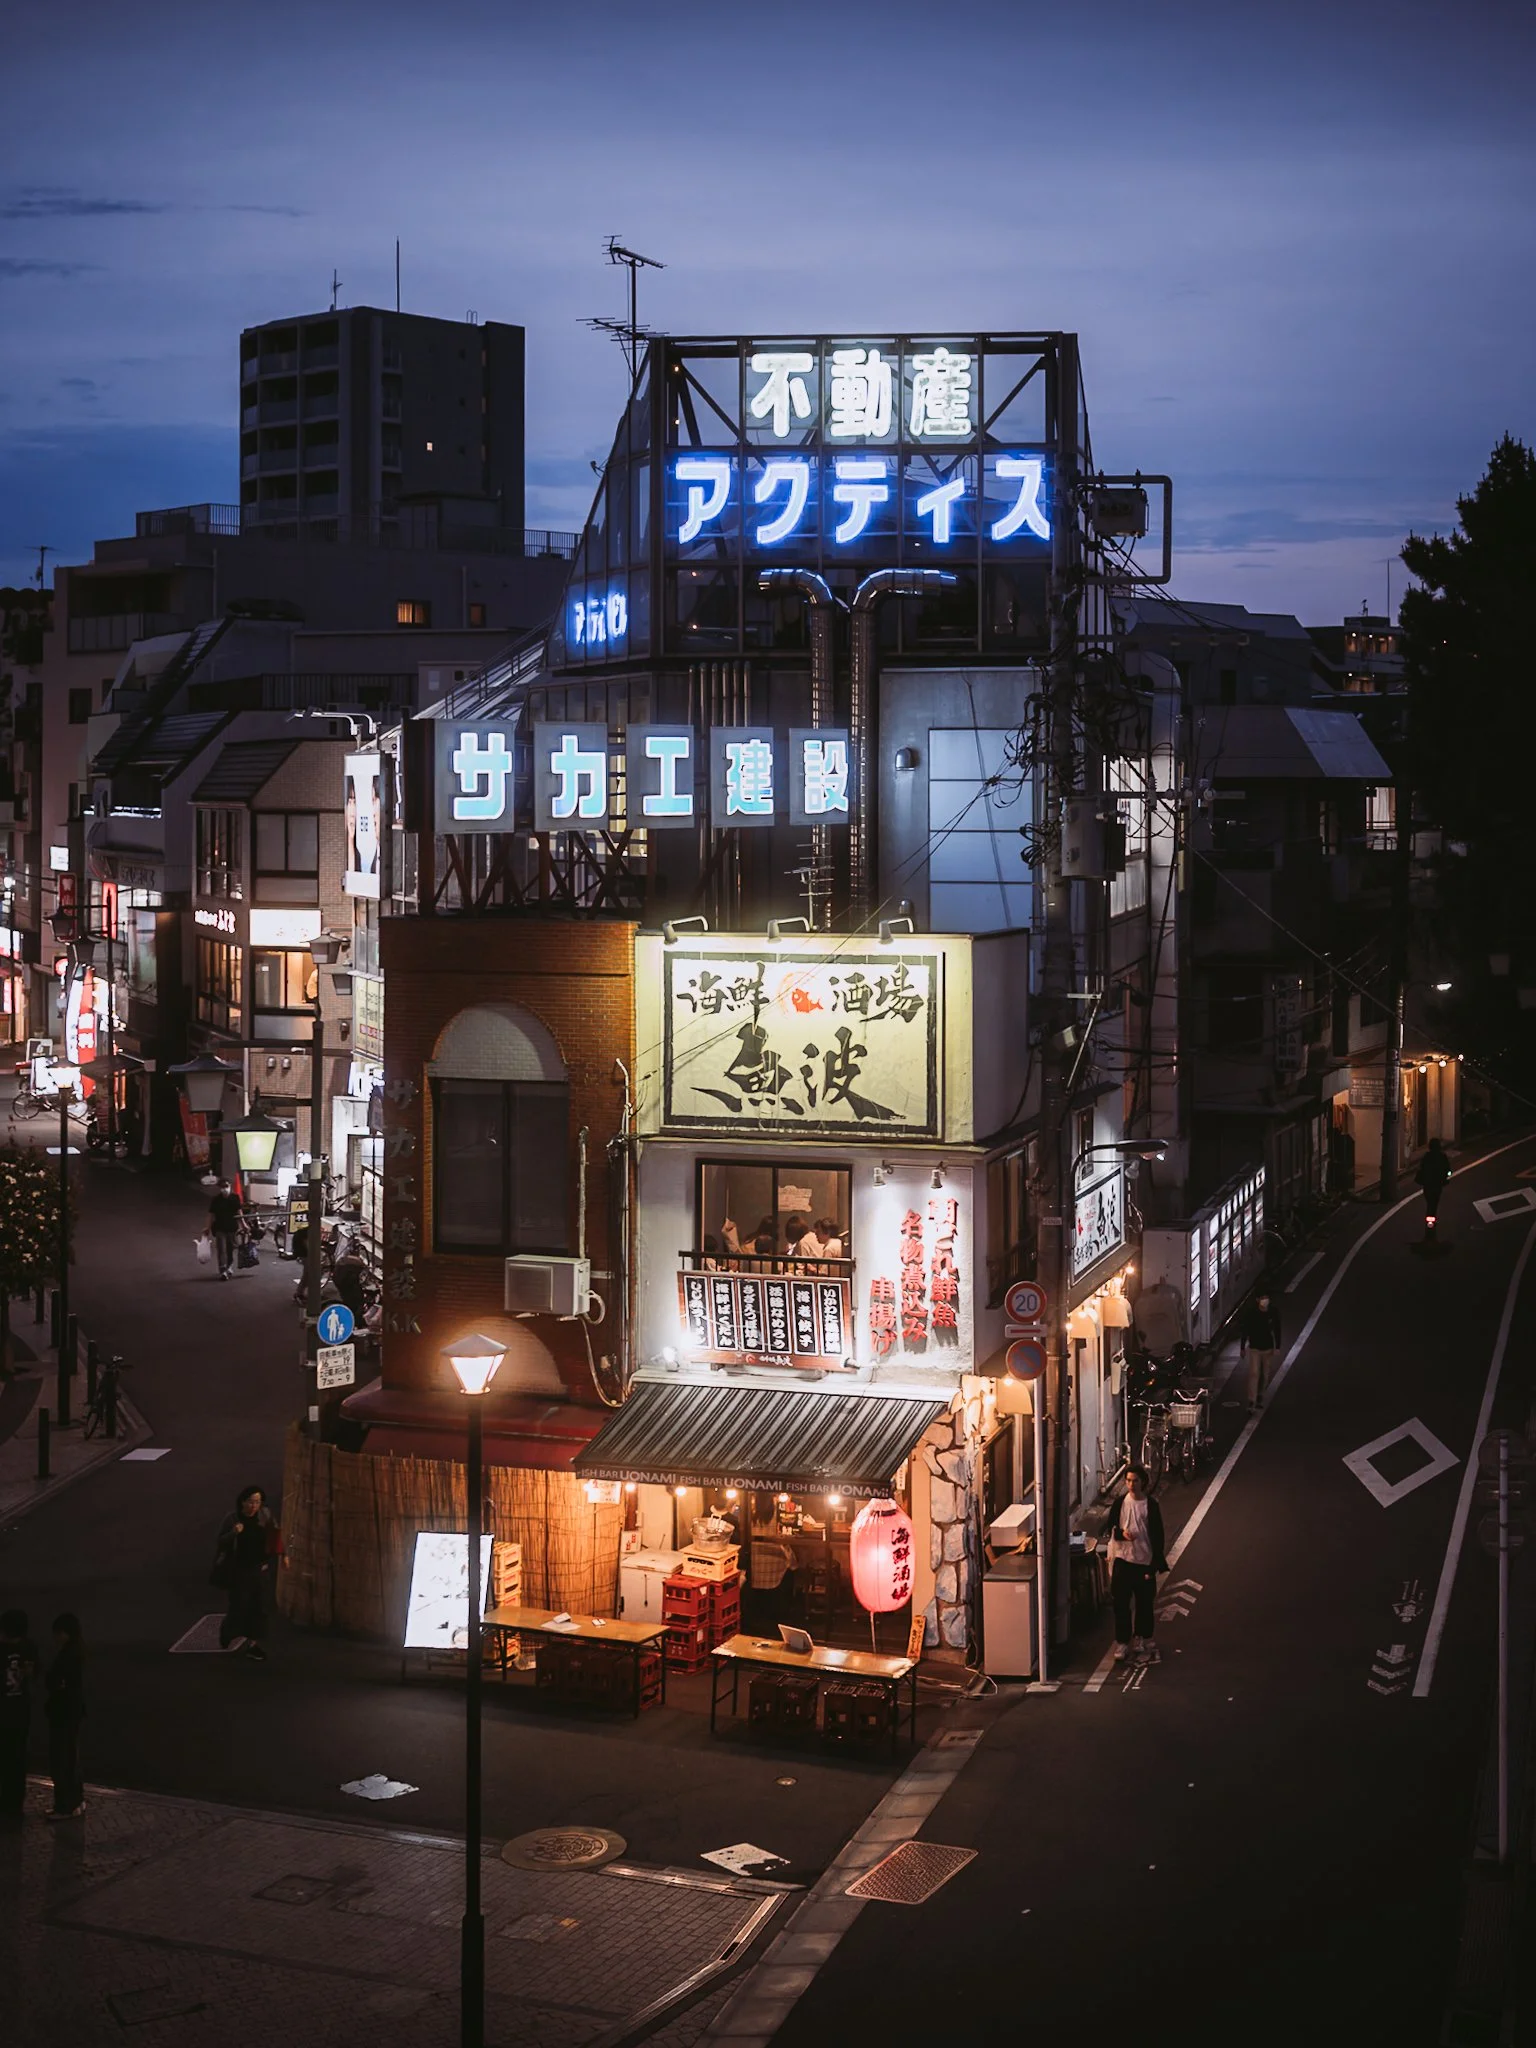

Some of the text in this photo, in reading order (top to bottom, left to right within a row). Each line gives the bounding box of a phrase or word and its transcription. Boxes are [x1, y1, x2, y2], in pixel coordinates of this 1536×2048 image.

[750, 347, 972, 439] 不動産
[675, 459, 1050, 544] アクティス
[452, 732, 849, 820] サカエ建設
[676, 961, 926, 1024] 海鮮 酒場
[690, 1022, 908, 1120] 魚波
[869, 1276, 898, 1357] 串揚げ
[900, 1207, 929, 1343] 名物煮込み
[1015, 1294, 1037, 1312] 20
[599, 1468, 618, 1479] BAR
[620, 1470, 677, 1484] UONAMI
[680, 1475, 702, 1487] FISH
[703, 1477, 723, 1487] BAR
[724, 1479, 783, 1492] UONAMI
[786, 1482, 808, 1492] FISH
[809, 1484, 830, 1494] BAR
[891, 1527, 912, 1601] 海鮮酒場
